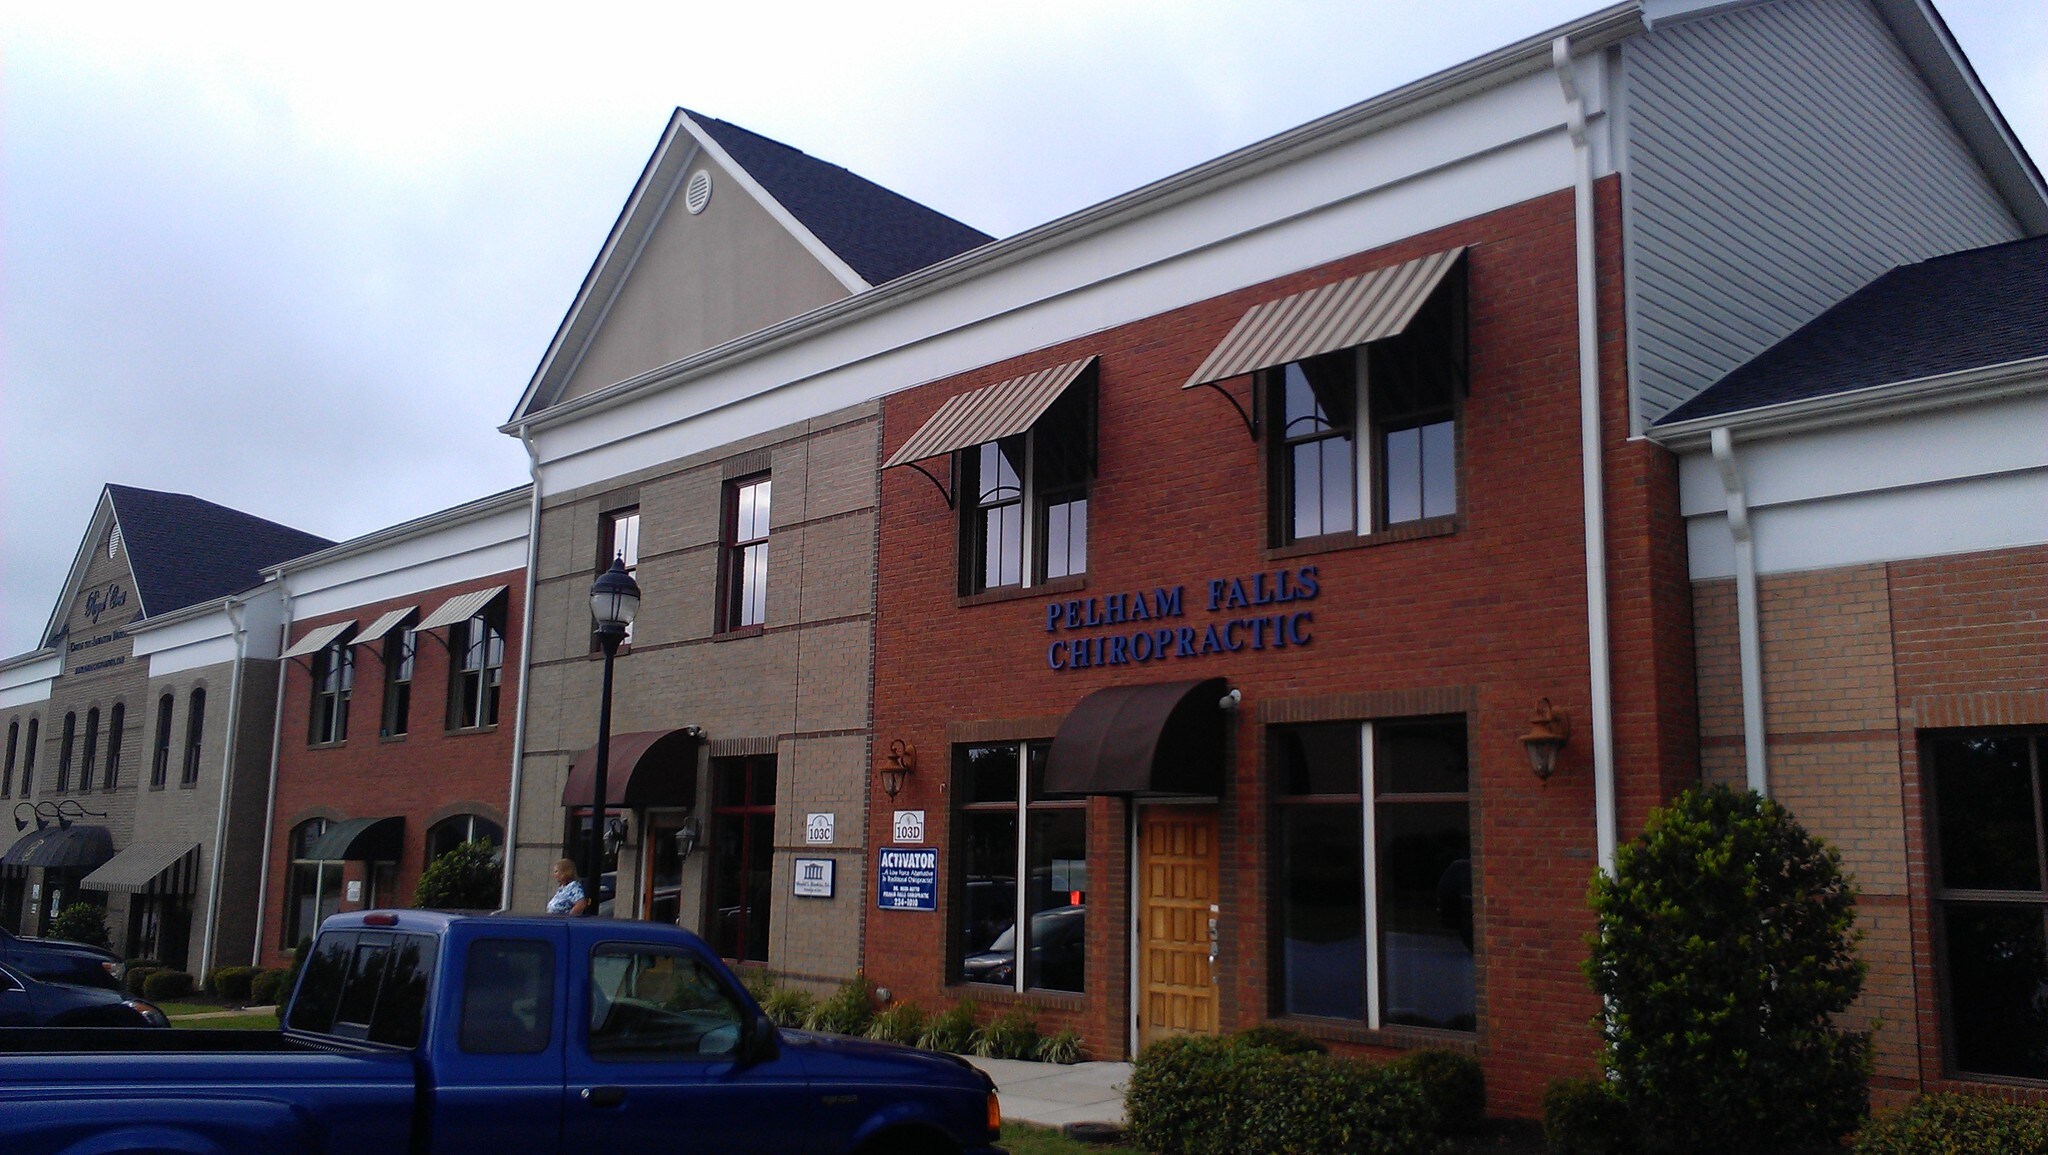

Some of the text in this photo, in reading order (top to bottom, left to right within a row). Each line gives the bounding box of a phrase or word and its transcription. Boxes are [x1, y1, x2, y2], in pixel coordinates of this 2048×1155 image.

[1045, 565, 1320, 632] PELHAM FALLS
[1047, 611, 1314, 670] CHIROPRACTIC
[809, 828, 831, 840] 103C
[896, 826, 920, 838] 103D
[881, 852, 935, 869] ACTIVATOR
